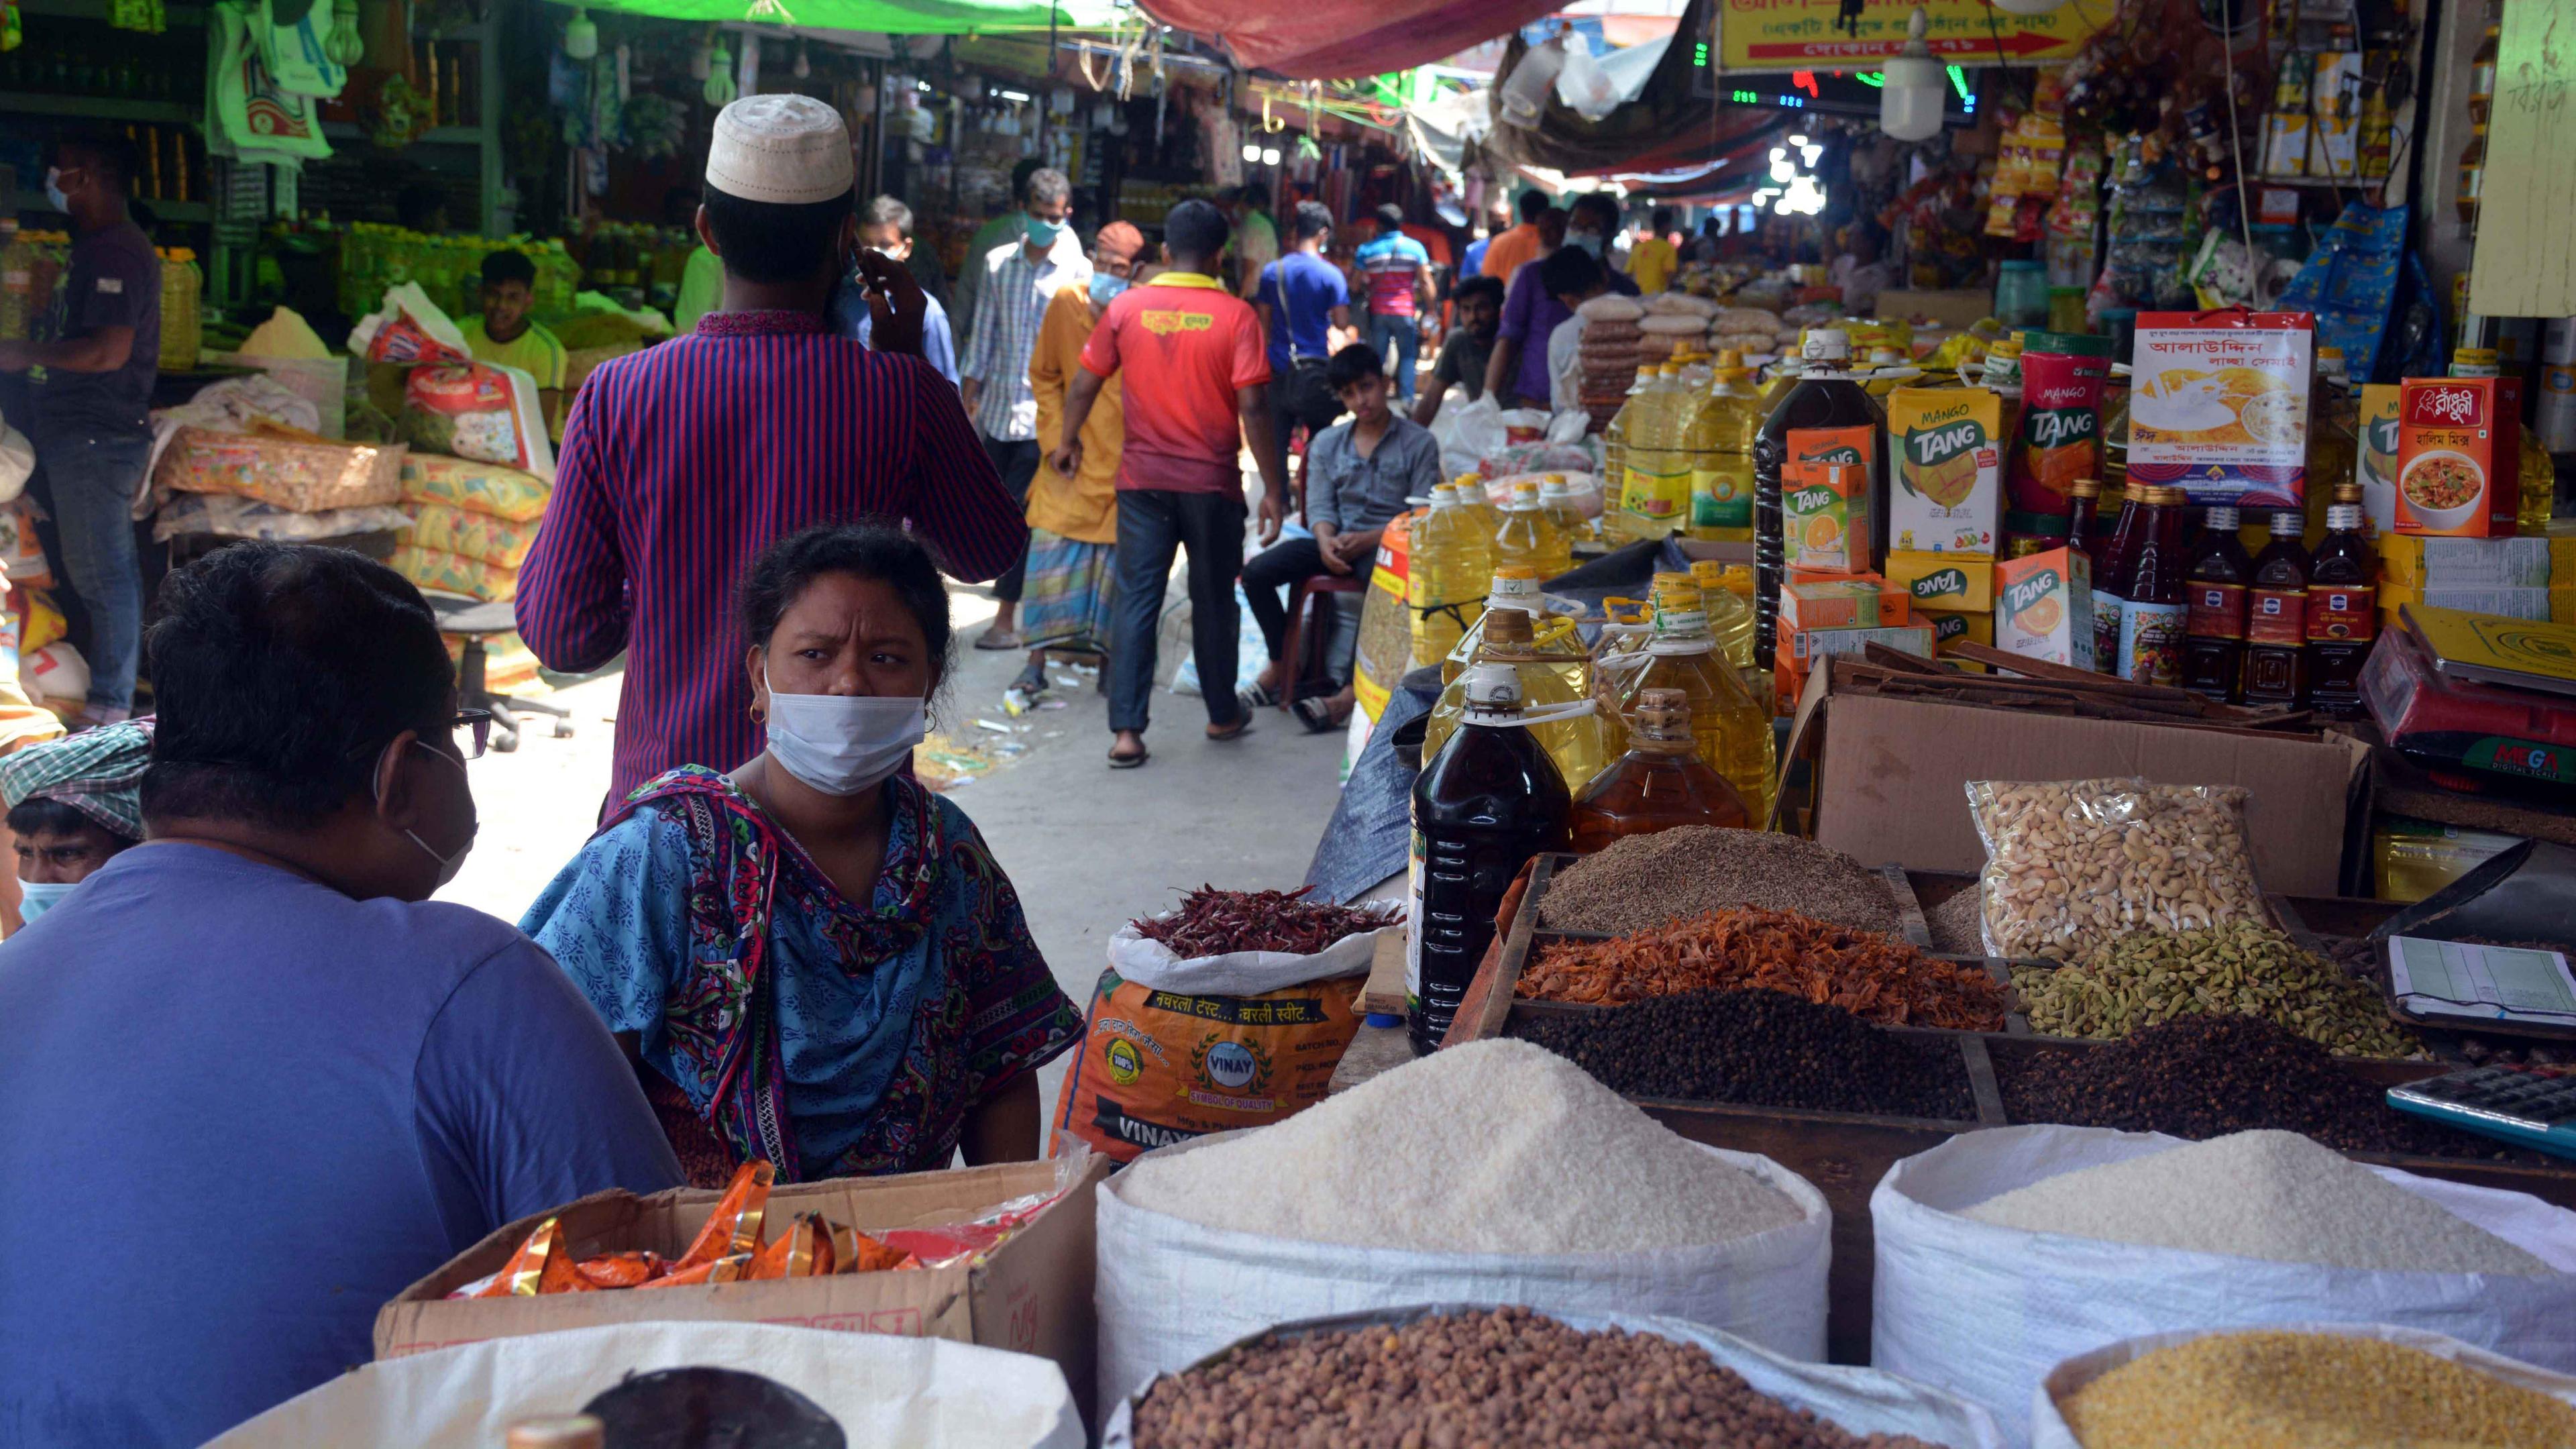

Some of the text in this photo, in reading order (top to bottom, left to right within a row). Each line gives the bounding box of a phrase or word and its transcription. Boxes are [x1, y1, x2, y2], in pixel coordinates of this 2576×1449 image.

[2148, 339, 2263, 354] আলাউদ্দিন
[2043, 386, 2087, 400] MANGO
[1921, 404, 1970, 424] MANGO
[2435, 387, 2473, 424] রাঁধুনী
[2031, 413, 2092, 443] TANG
[1914, 425, 1976, 464] TANG
[2416, 431, 2469, 447] হালিম মিক্স
[1792, 490, 1830, 513] TANG
[1917, 571, 1961, 595] TANG
[2008, 574, 2053, 612] TANG
[2493, 743, 2559, 773] MEGA
[2492, 762, 2557, 779] DIGITAL SCALE
[1113, 1053, 1134, 1071] 100%
[1210, 1055, 1252, 1074] VINAY
[1190, 1091, 1273, 1110] SYMBOL OF QUALITY
